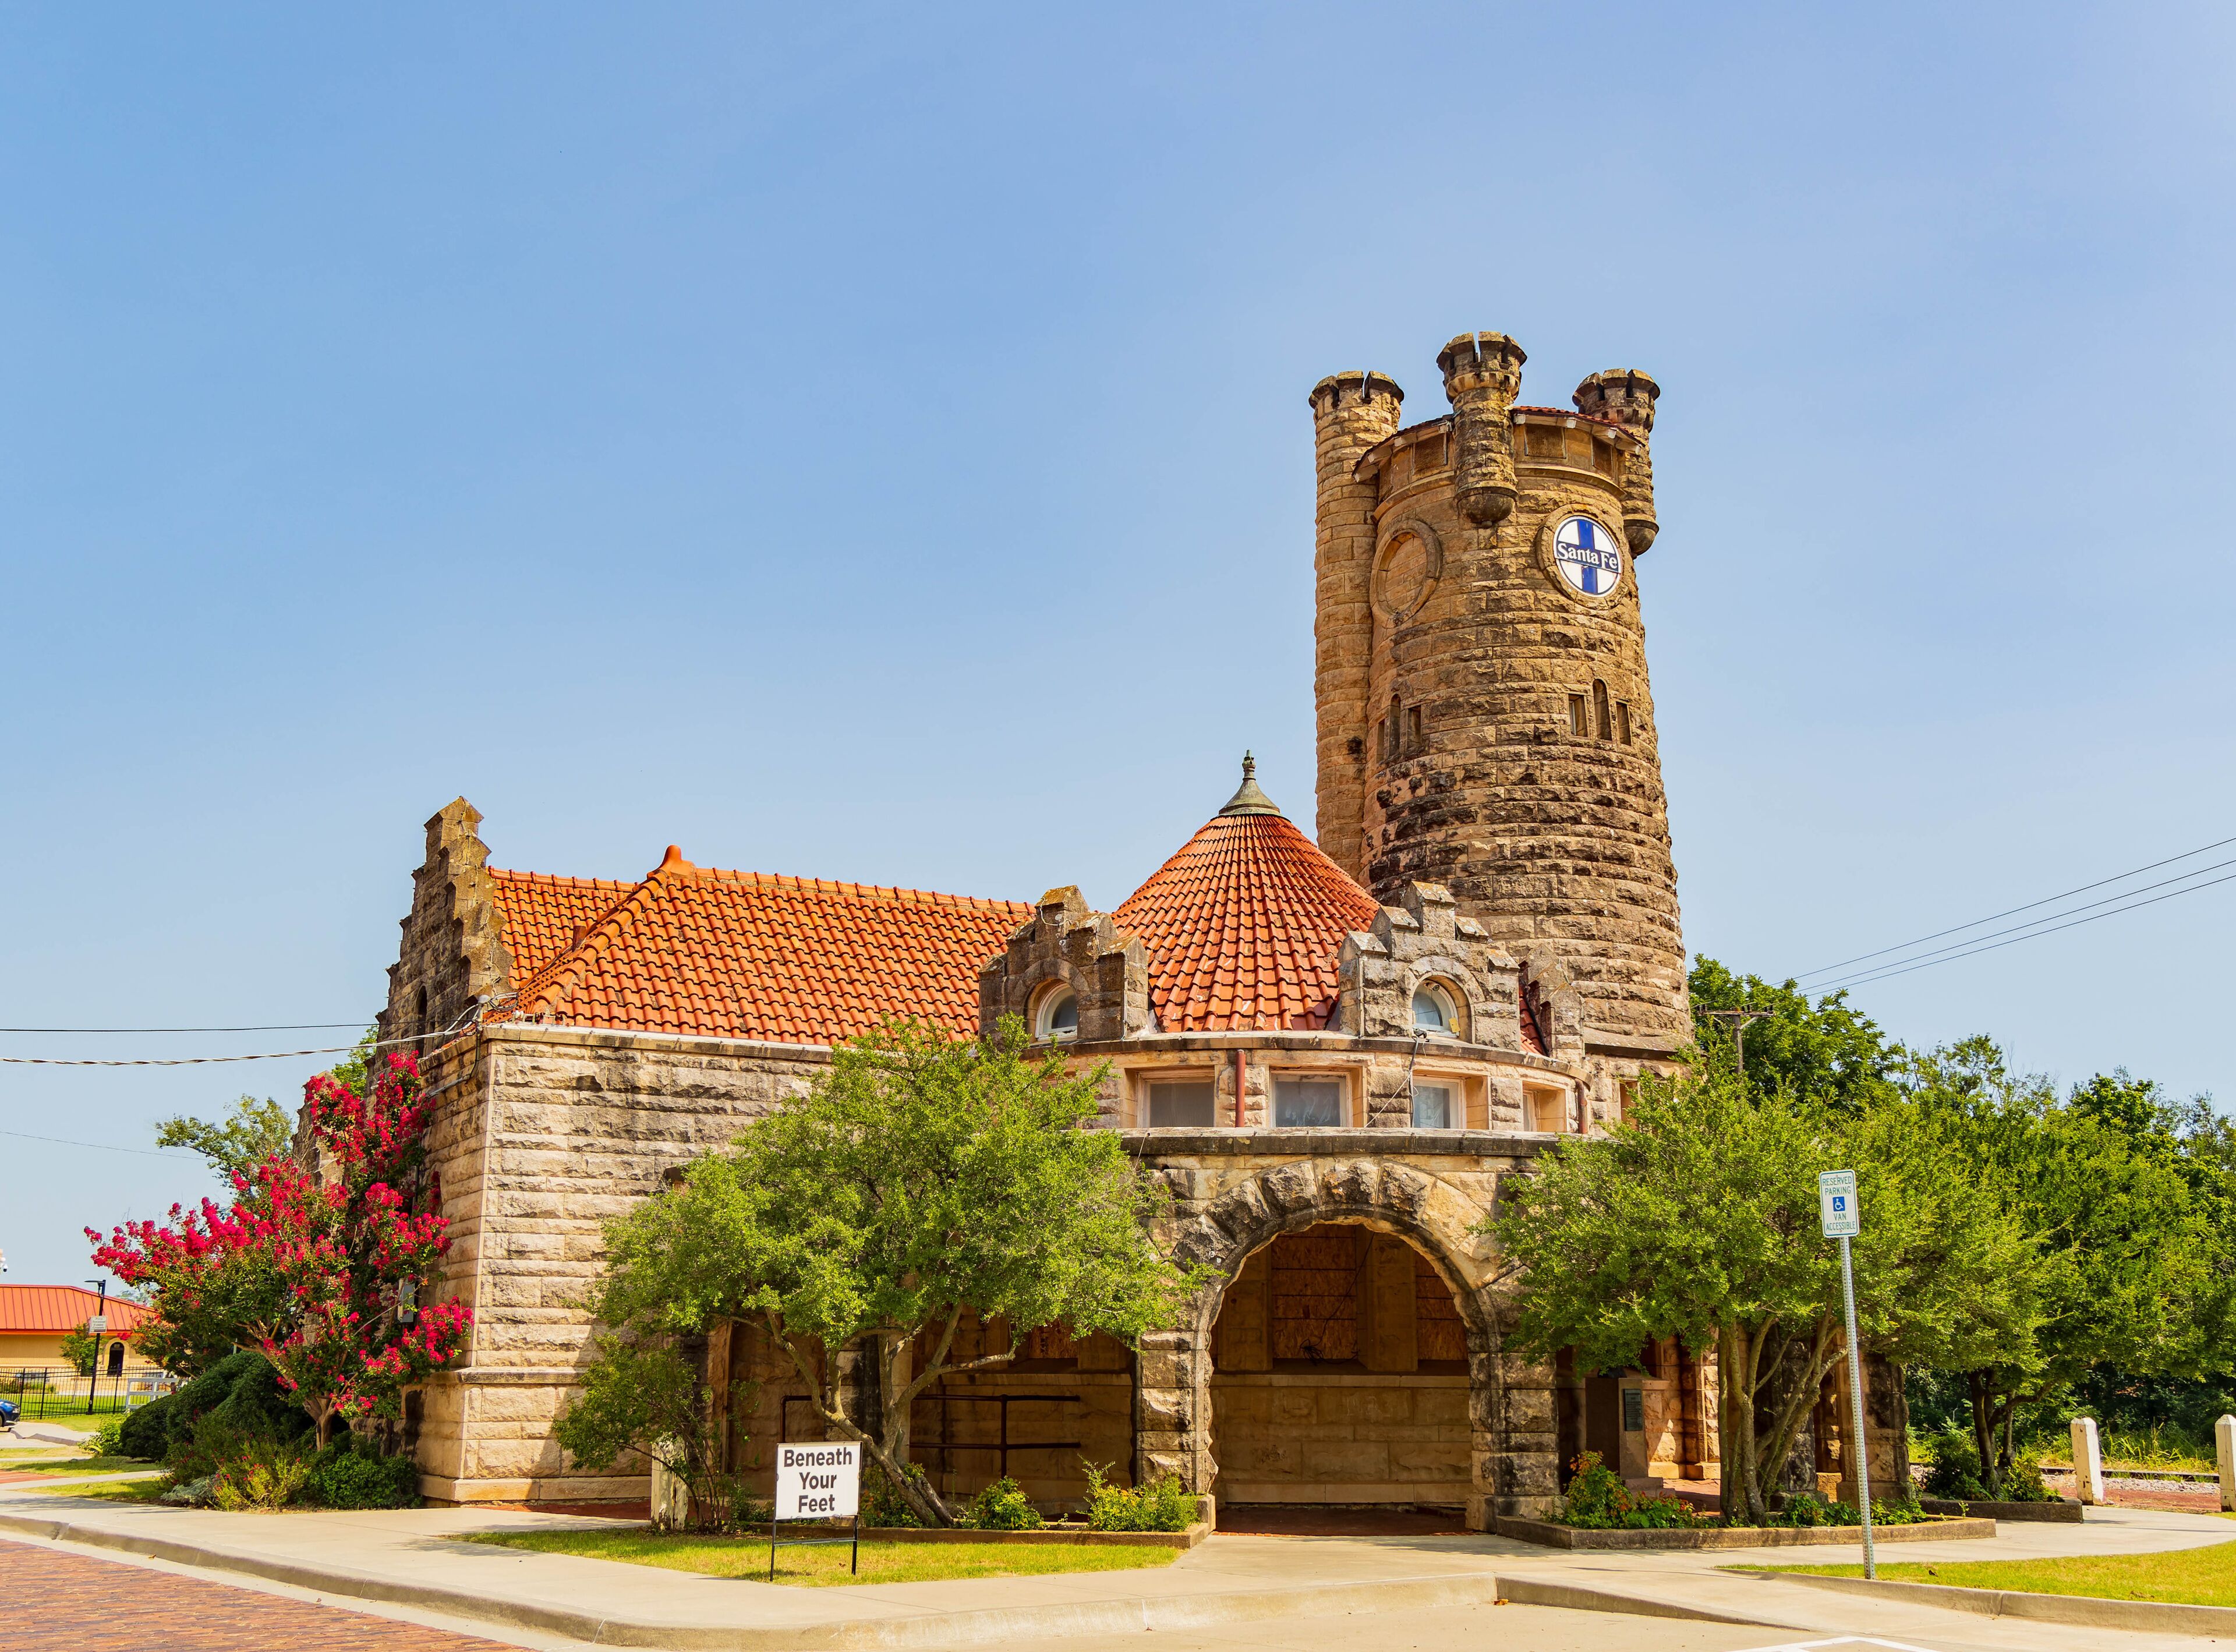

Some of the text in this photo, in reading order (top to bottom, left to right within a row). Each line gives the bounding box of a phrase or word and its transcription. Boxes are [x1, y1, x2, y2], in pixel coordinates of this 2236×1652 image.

[1558, 543, 1618, 569] Santa Fe
[1822, 1176, 1852, 1186] RESERVED
[1825, 1186, 1851, 1195] PARKING
[1826, 1221, 1856, 1230] ACCESSIBLE
[784, 1447, 852, 1467] Beneath
[799, 1471, 837, 1490] Your
[798, 1494, 835, 1513] Feet
